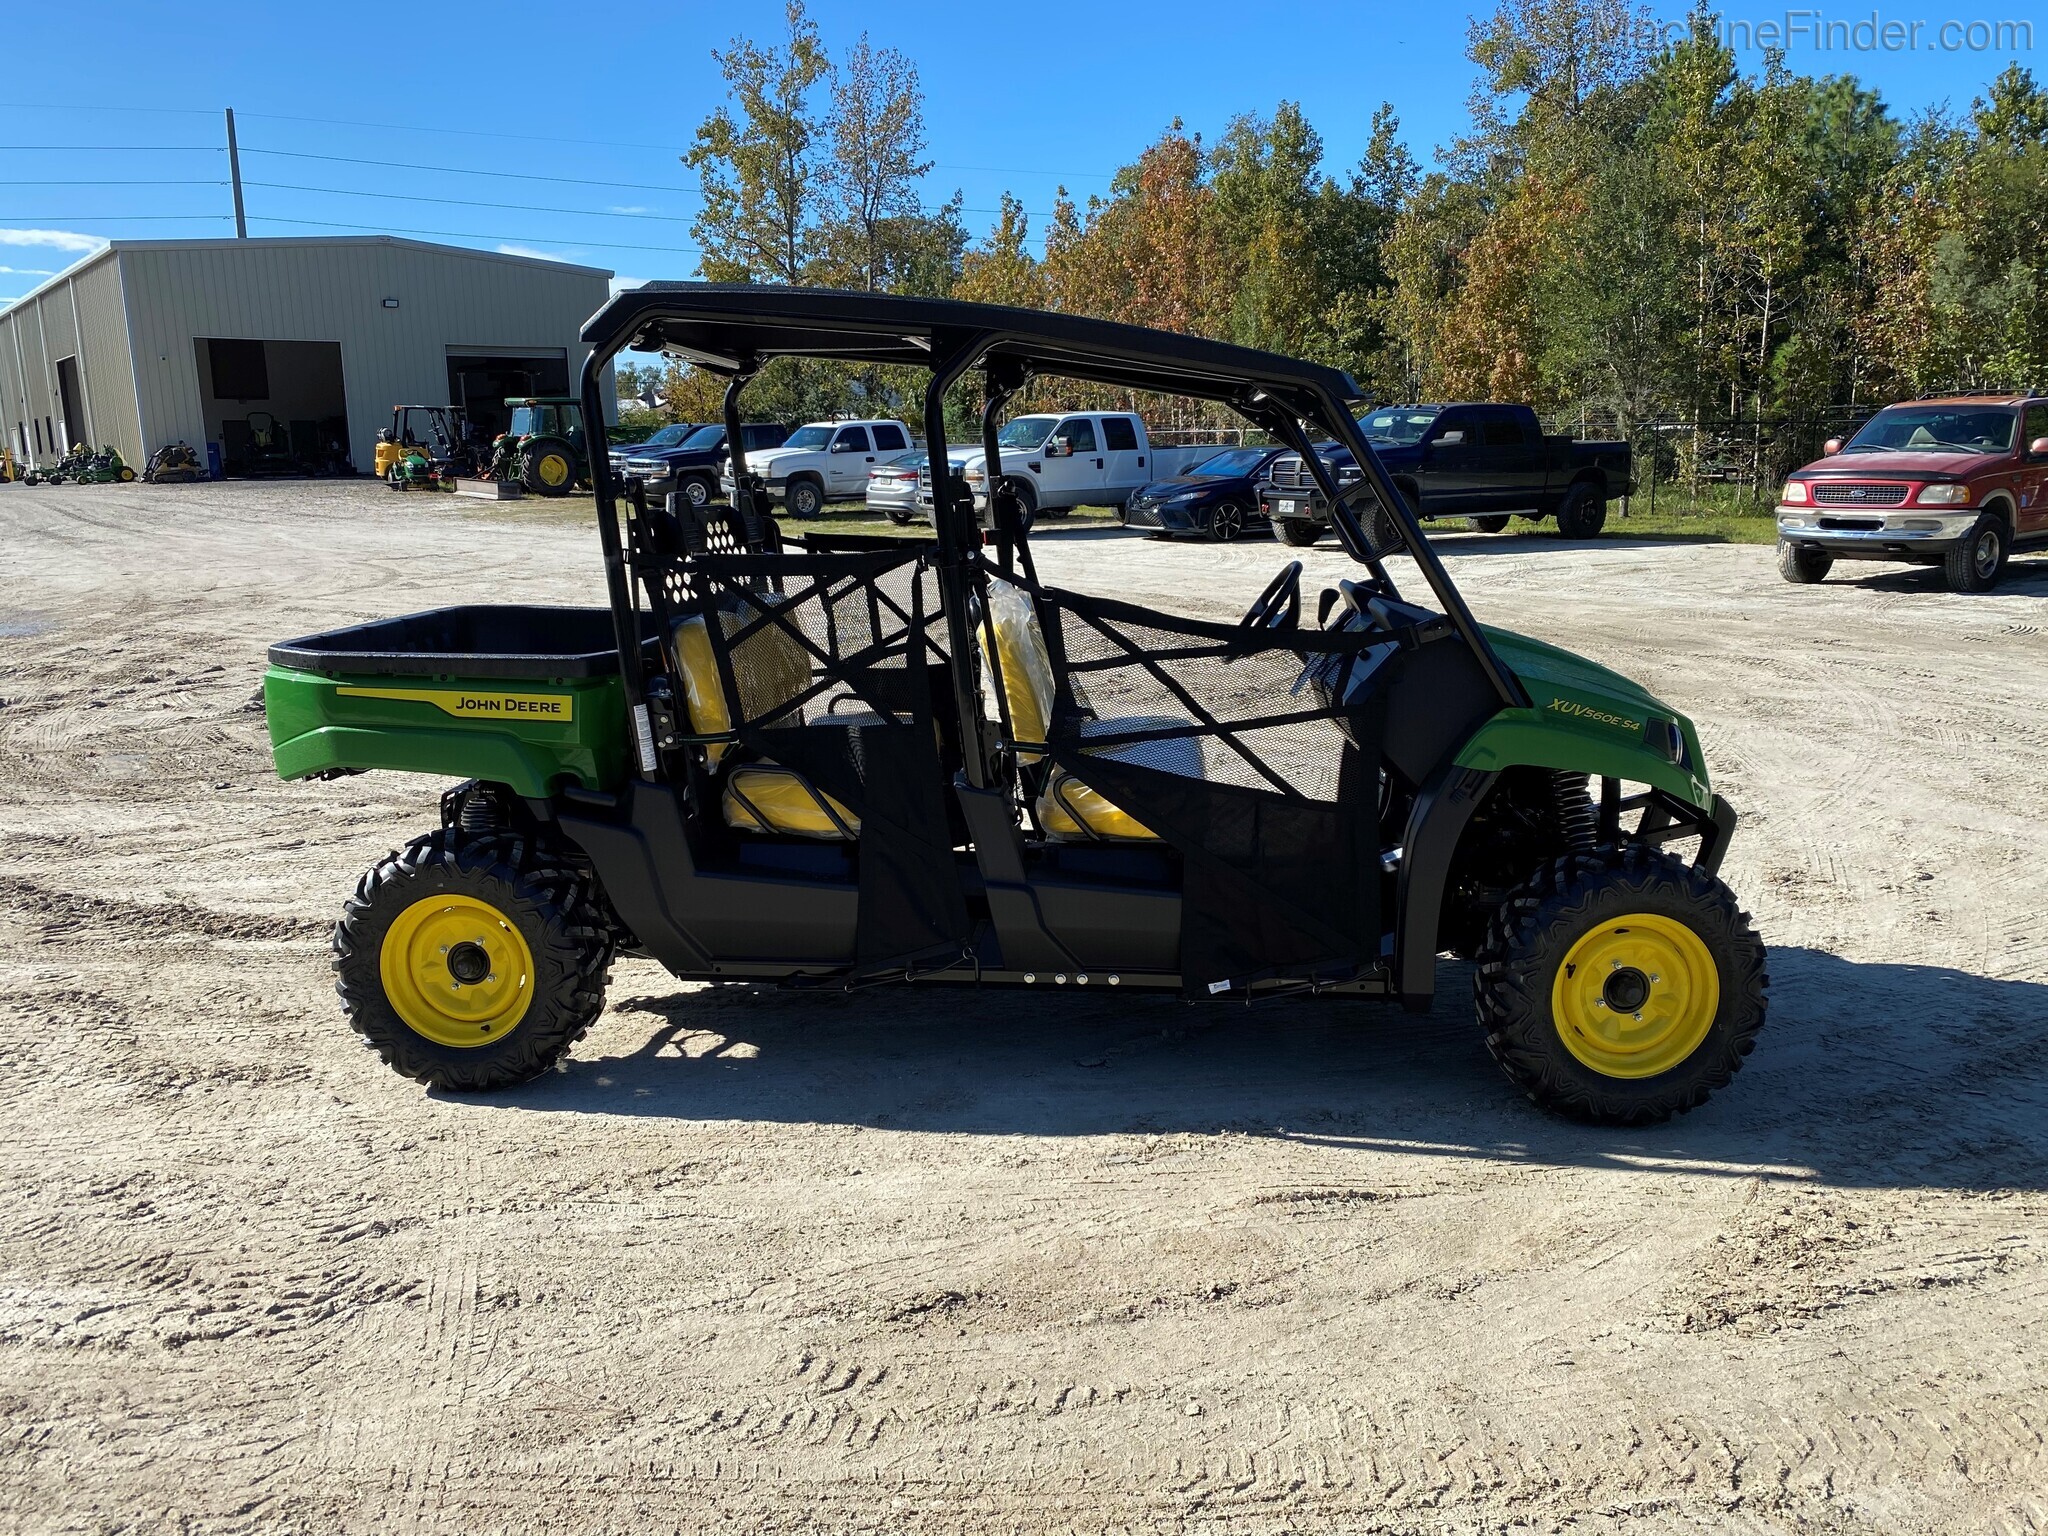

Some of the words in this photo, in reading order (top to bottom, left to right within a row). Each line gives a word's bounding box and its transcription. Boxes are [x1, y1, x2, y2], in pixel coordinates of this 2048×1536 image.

[456, 697, 500, 711] JOHN
[505, 698, 561, 713] DEERE
[1547, 698, 1622, 725] XUV560E
[1621, 720, 1640, 731] S4
